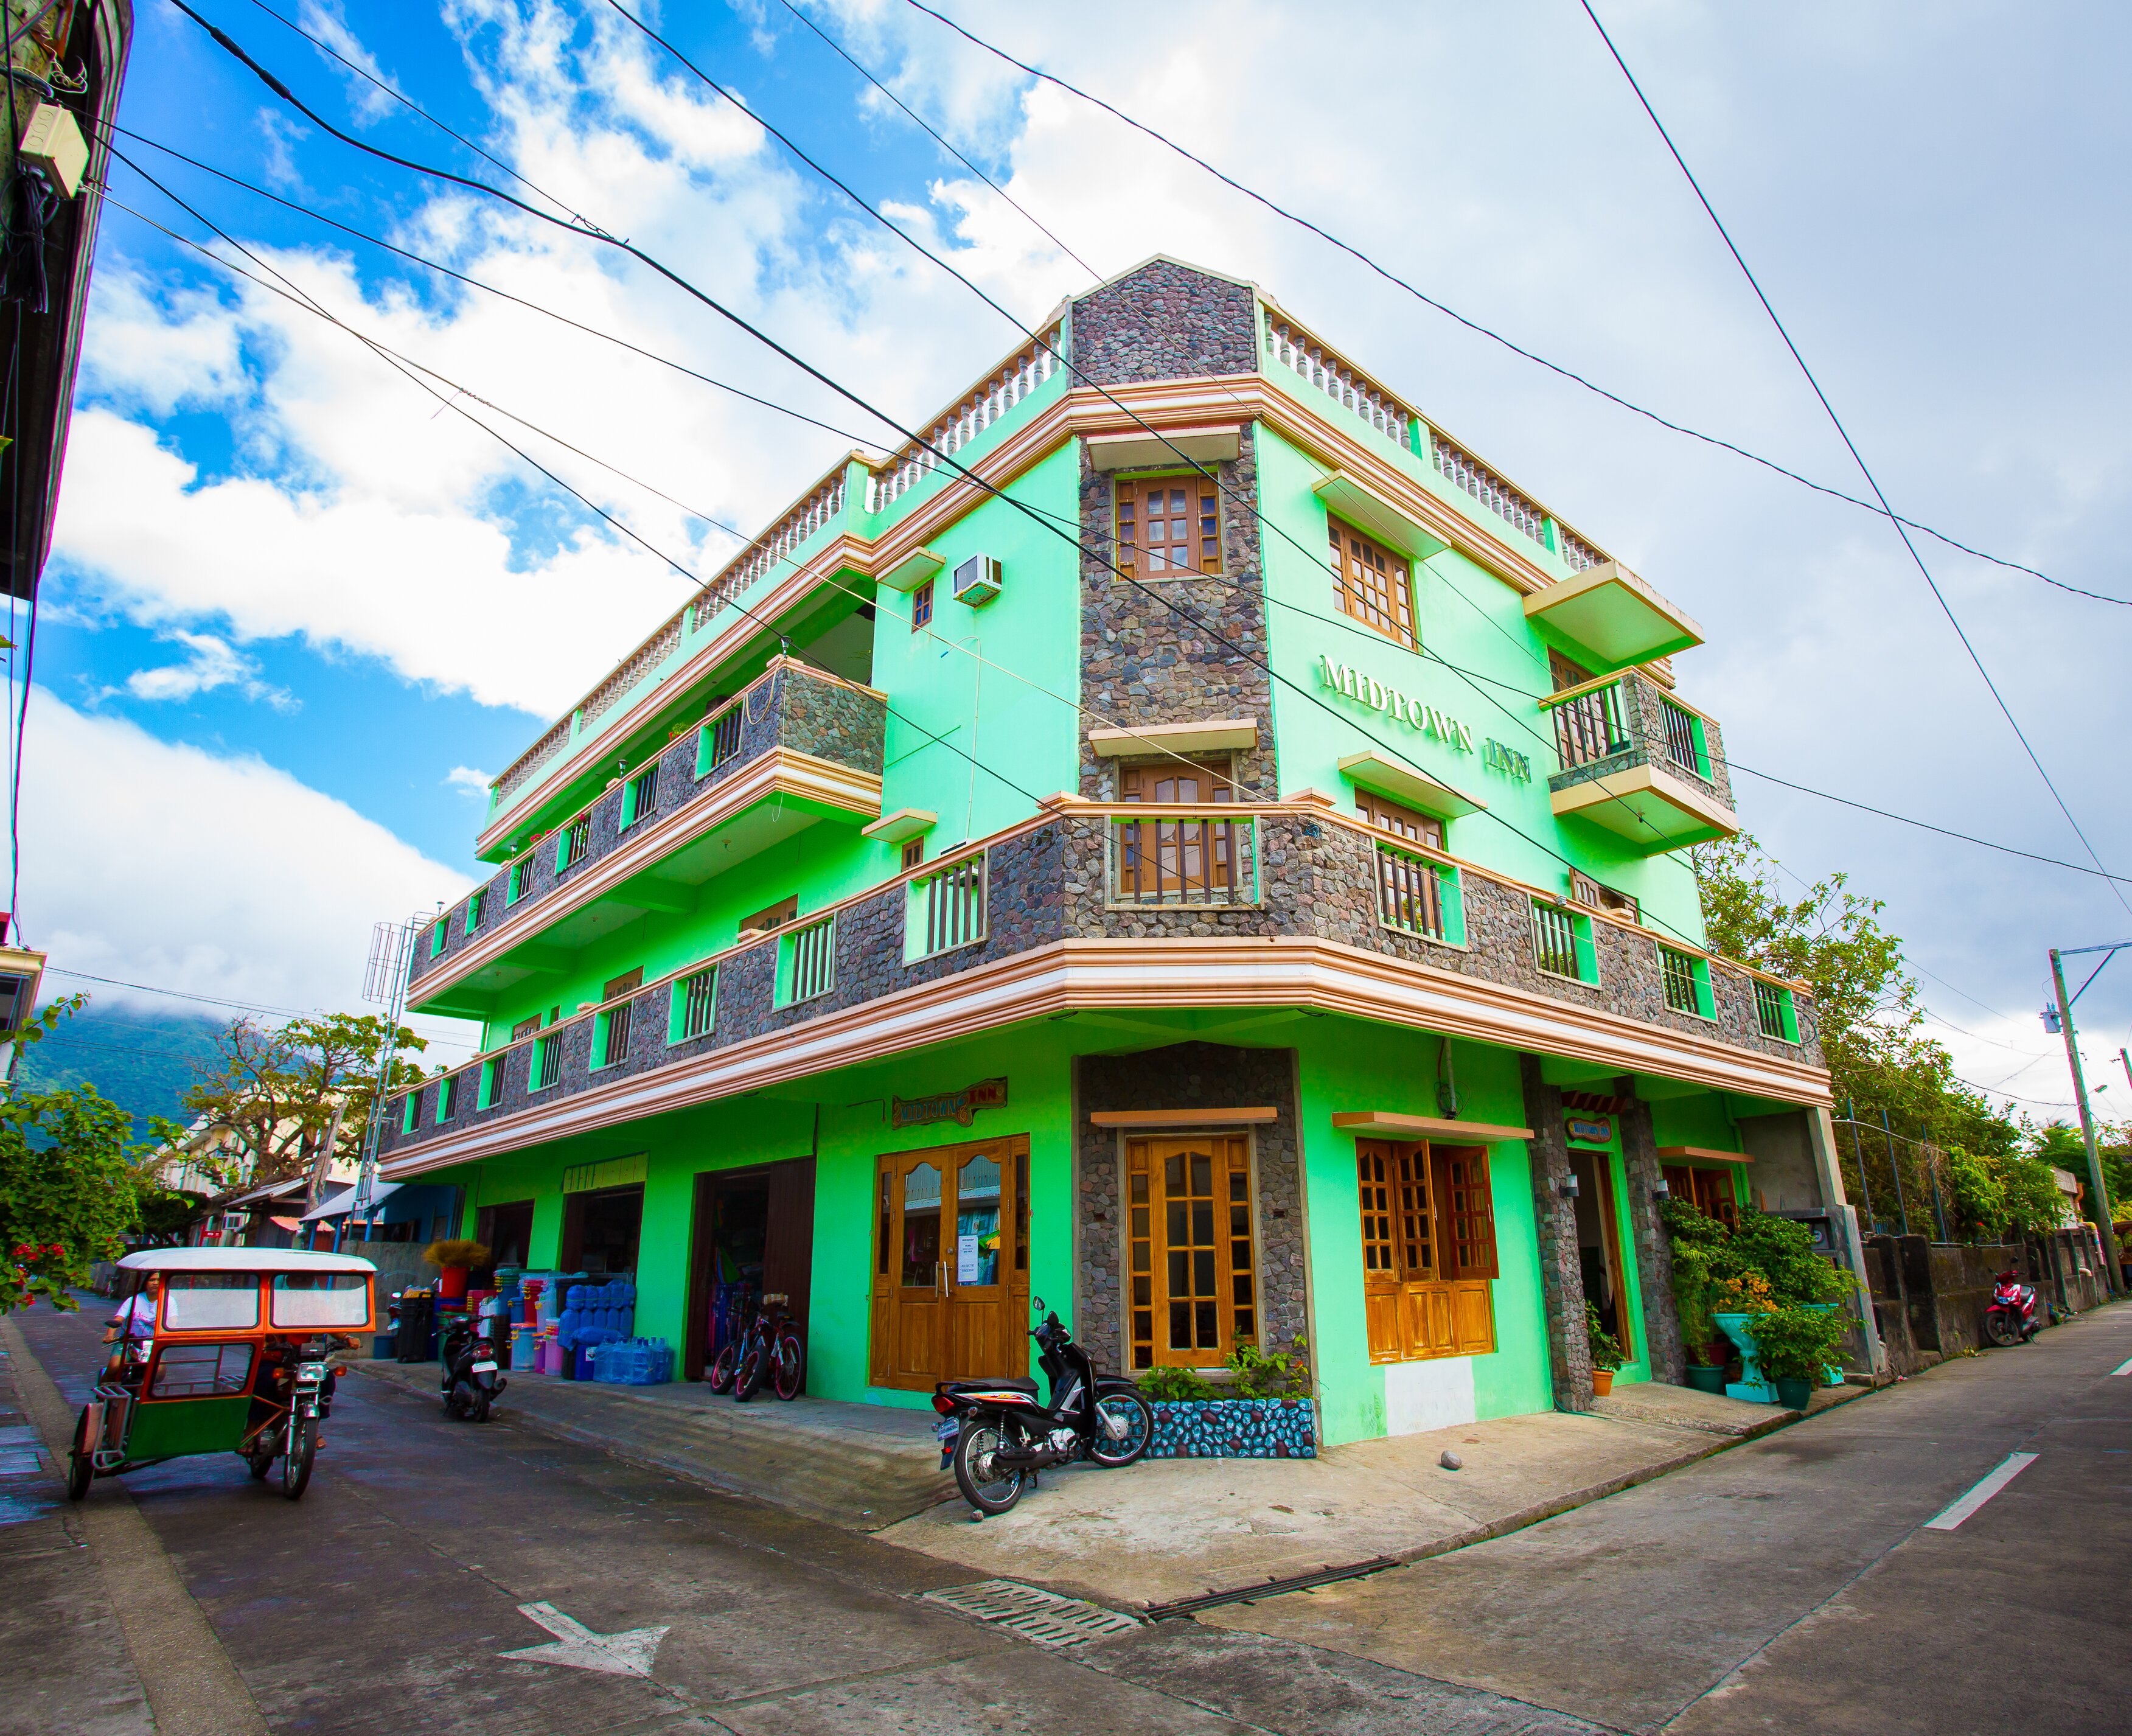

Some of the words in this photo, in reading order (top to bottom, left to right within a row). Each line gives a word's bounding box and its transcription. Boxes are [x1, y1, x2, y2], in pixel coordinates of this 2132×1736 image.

[1319, 654, 1474, 755] MIDTOWN
[1485, 737, 1531, 784] INN
[900, 1098, 956, 1121] MIDTOWN
[968, 1084, 997, 1104] INN
